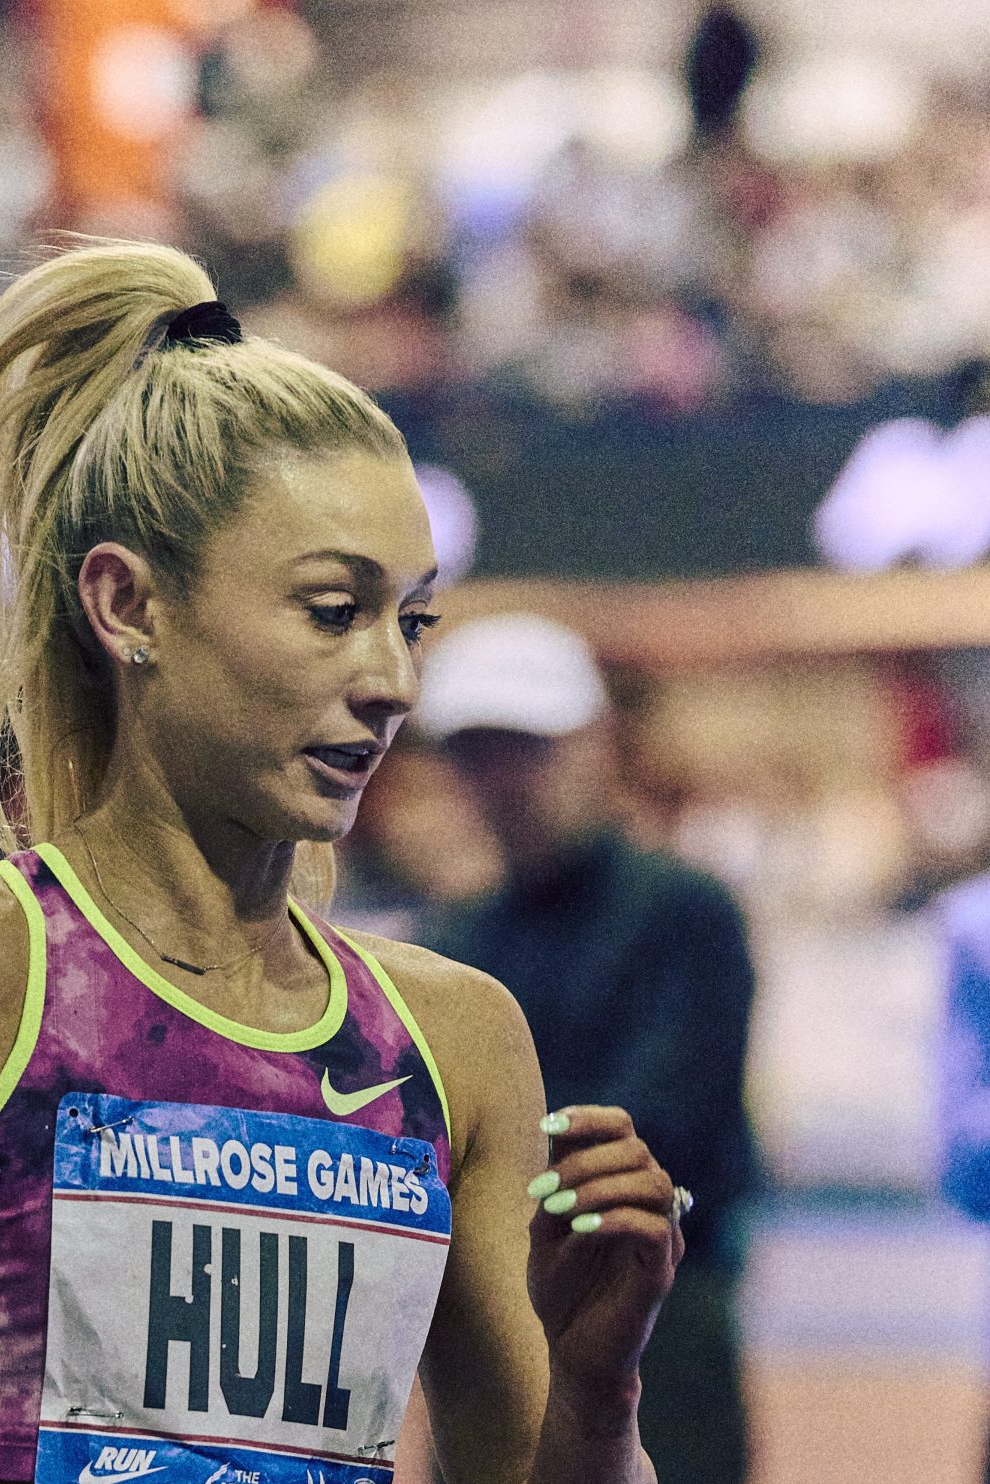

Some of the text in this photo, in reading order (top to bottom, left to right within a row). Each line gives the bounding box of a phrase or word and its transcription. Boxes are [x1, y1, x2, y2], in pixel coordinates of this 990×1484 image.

[99, 1130, 429, 1215] MILLROSE GAMES
[144, 1220, 355, 1431] HULL
[94, 1446, 157, 1473] RUN
[235, 1469, 260, 1484] THE
